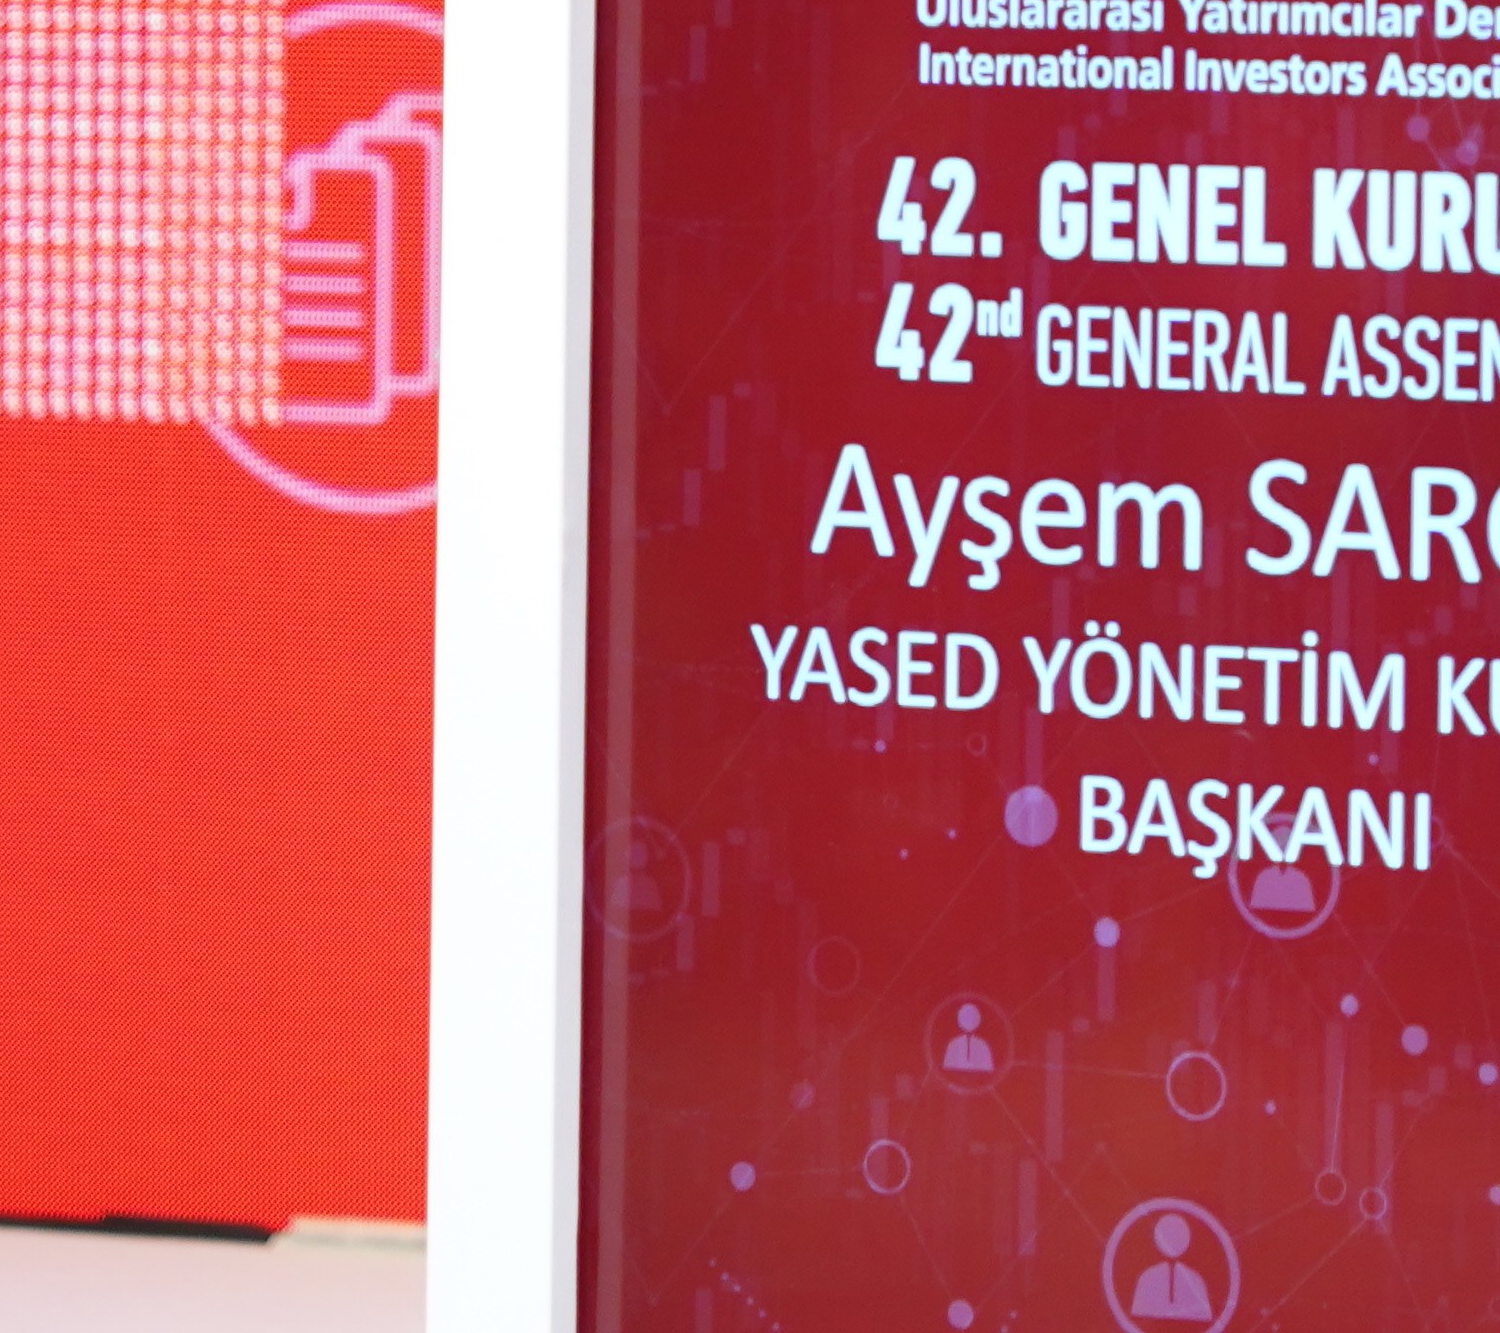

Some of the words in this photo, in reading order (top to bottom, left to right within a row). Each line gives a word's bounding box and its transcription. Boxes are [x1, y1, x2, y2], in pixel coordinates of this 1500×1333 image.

[918, 42, 1175, 92] International
[1184, 48, 1368, 97] Investors
[877, 156, 1003, 259] 42.
[1038, 160, 1288, 268] GENEL
[875, 282, 1024, 384] 42nd
[1035, 303, 1306, 396] GENERAL
[810, 443, 1204, 592] Ayşem
[750, 624, 1000, 711] YASED
[1023, 620, 1406, 733] YÖNETİM
[1079, 775, 1433, 880] BAŞKANI
